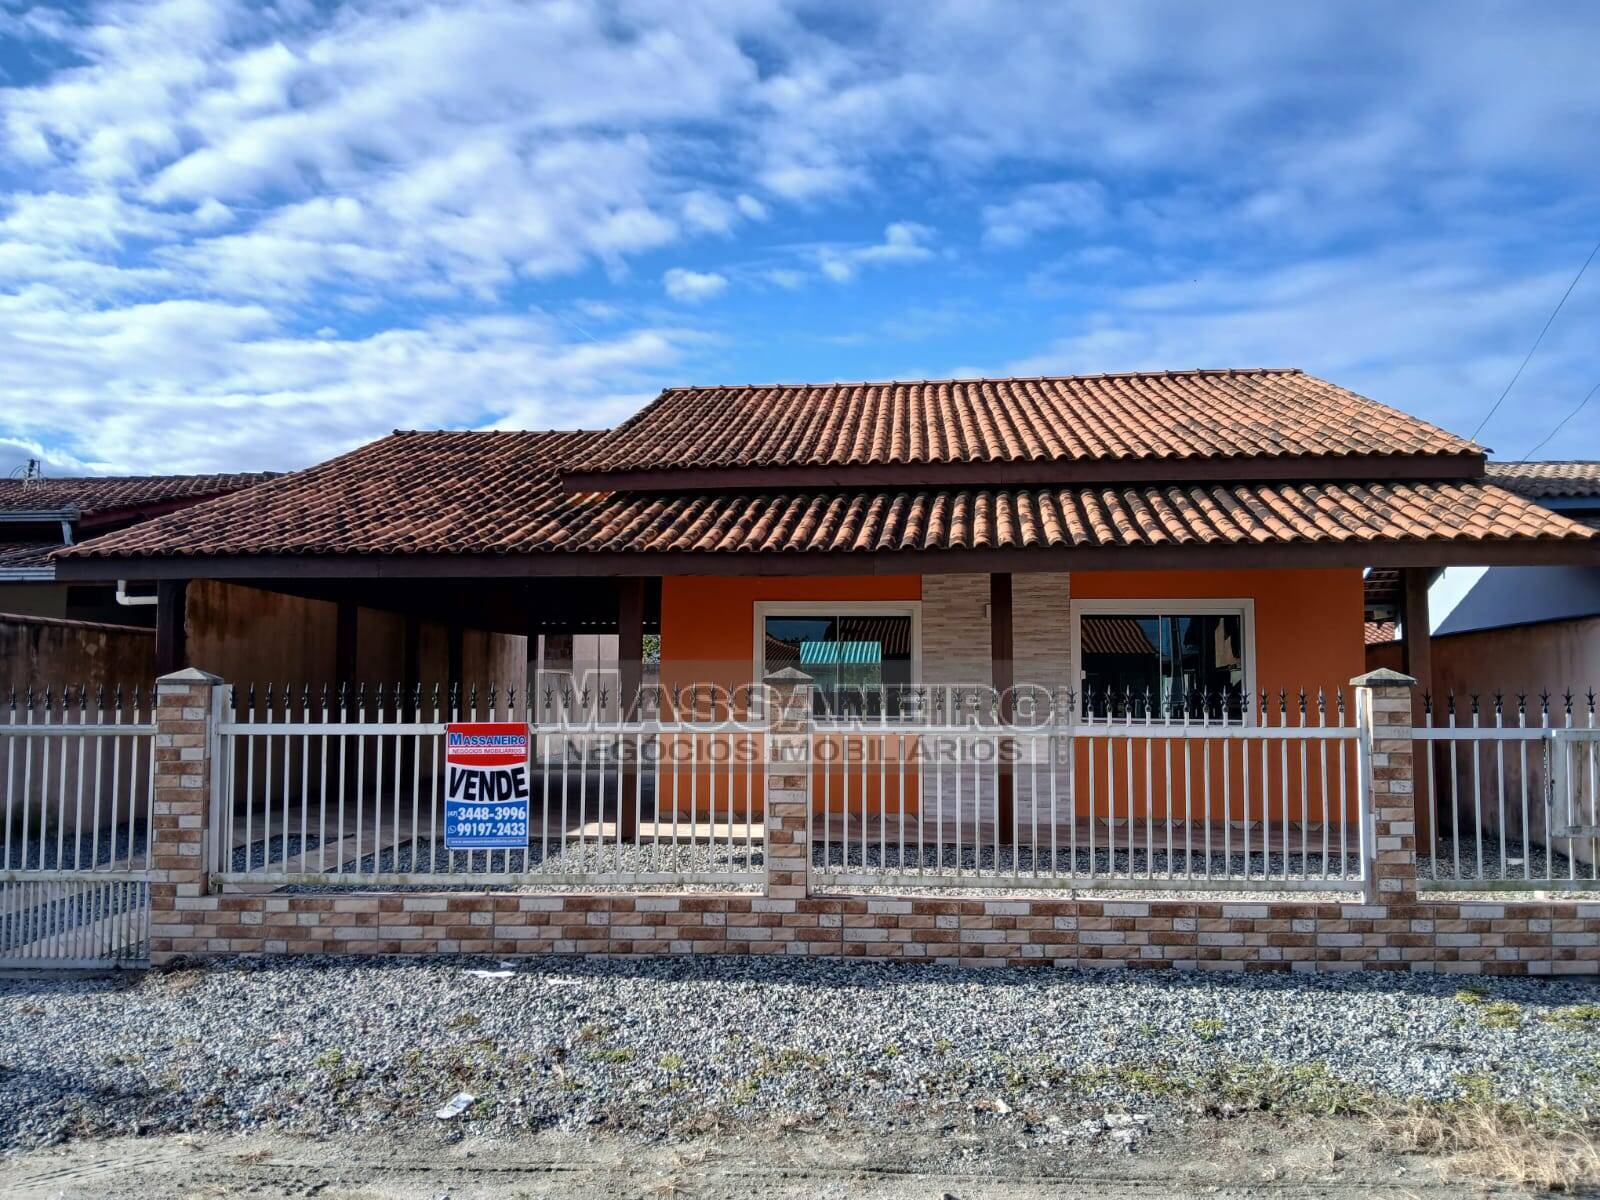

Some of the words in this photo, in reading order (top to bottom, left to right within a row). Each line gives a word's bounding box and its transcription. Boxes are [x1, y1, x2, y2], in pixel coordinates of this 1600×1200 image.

[449, 732, 526, 746] MASSANEIRO
[449, 766, 528, 801] VENDE
[458, 807, 526, 820] 3448-3996
[457, 822, 525, 836] 99197-2433
